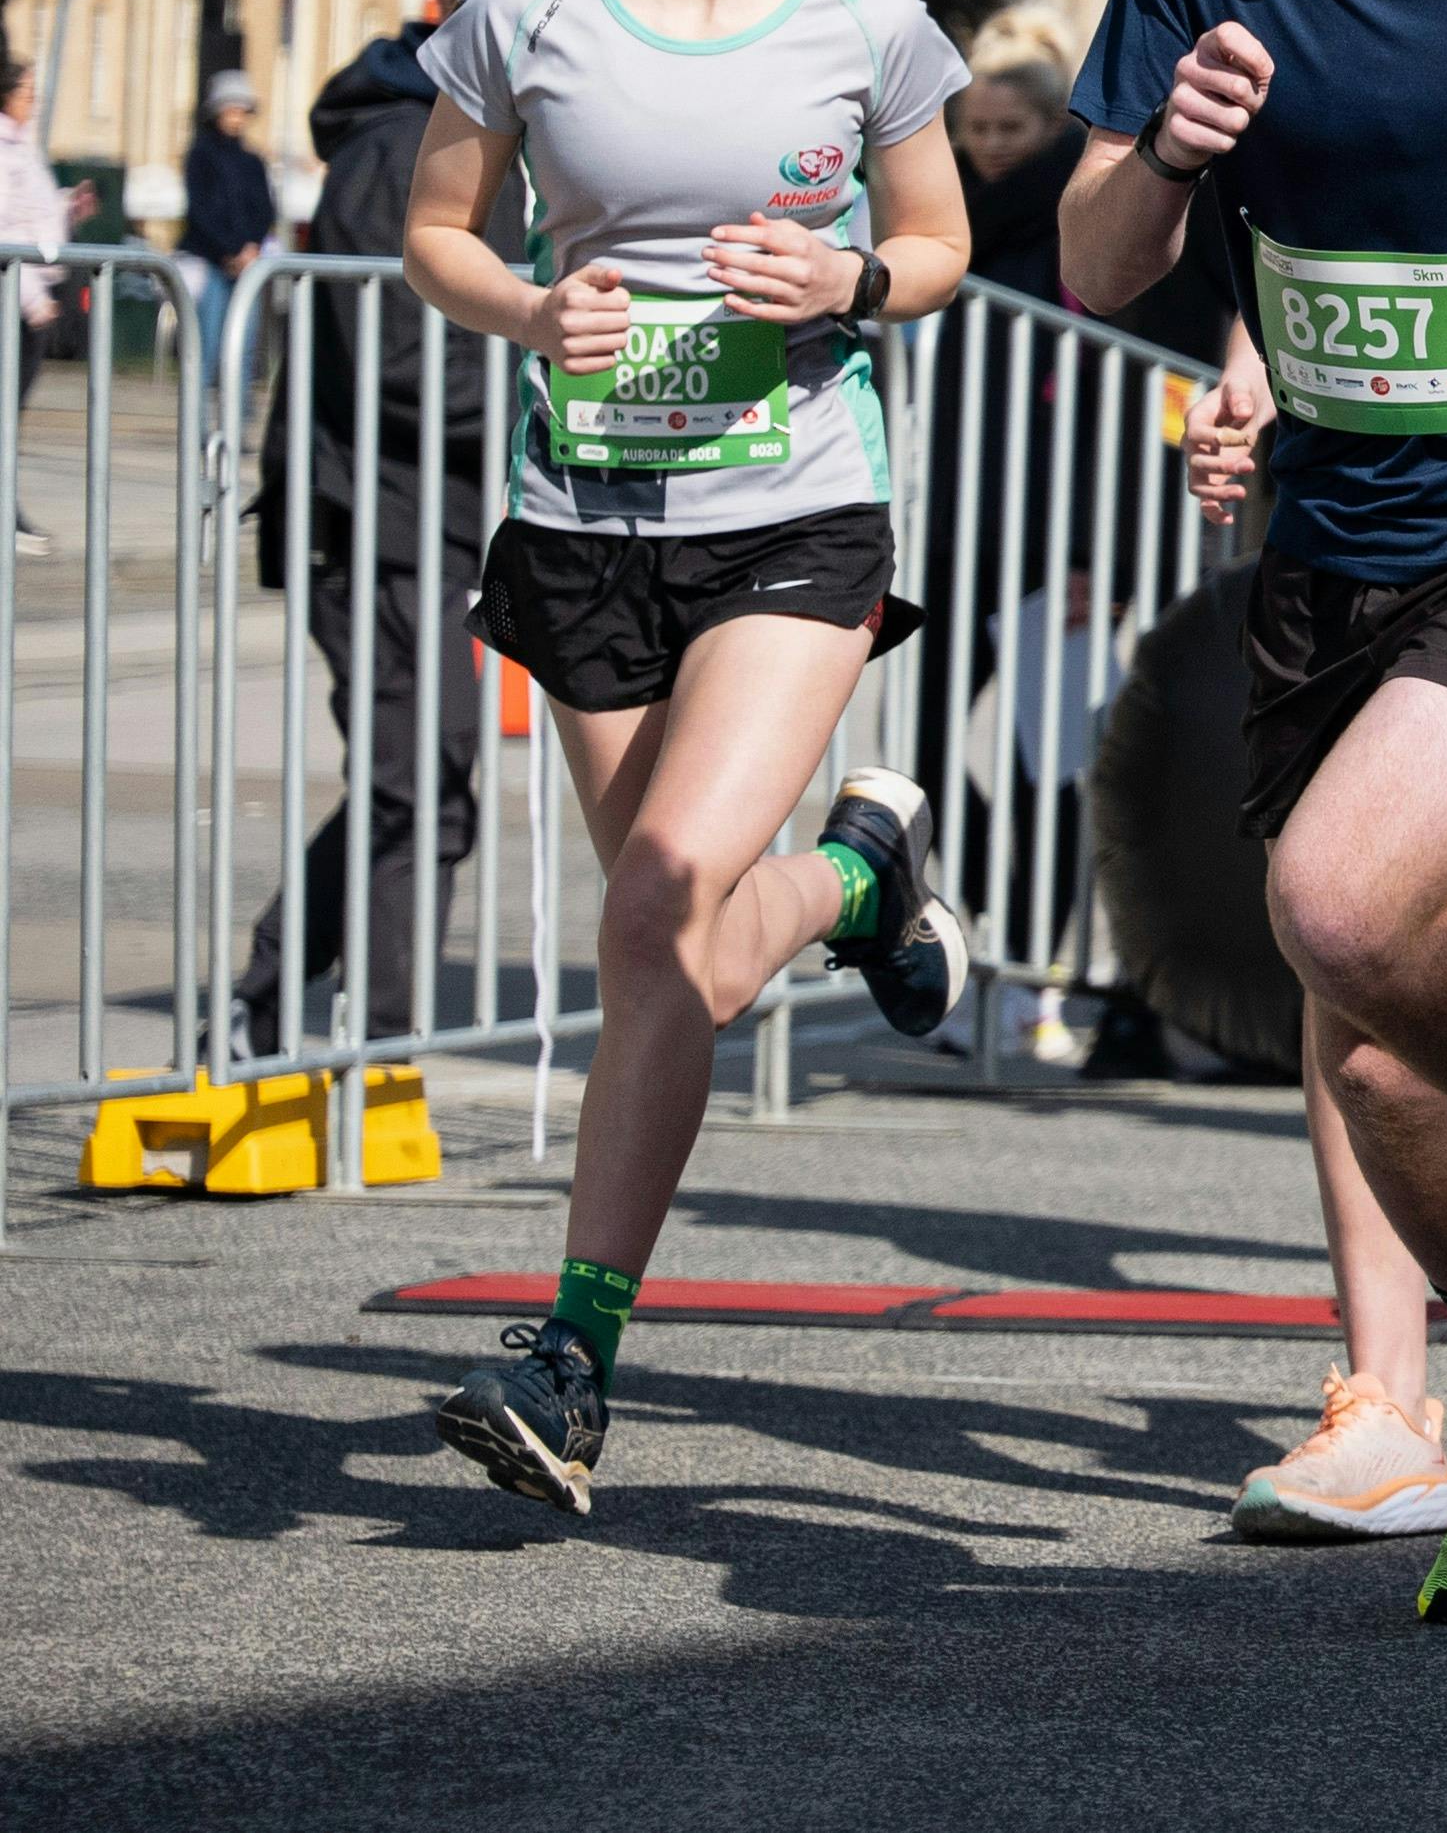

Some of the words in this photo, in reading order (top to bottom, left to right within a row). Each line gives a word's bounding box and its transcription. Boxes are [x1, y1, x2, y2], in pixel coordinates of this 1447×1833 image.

[767, 186, 840, 207] Athletics
[1412, 269, 1445, 282] 5km
[1281, 287, 1434, 360] 8257
[615, 325, 721, 363] OARS
[615, 365, 709, 401] 8020
[749, 442, 782, 457] 8020
